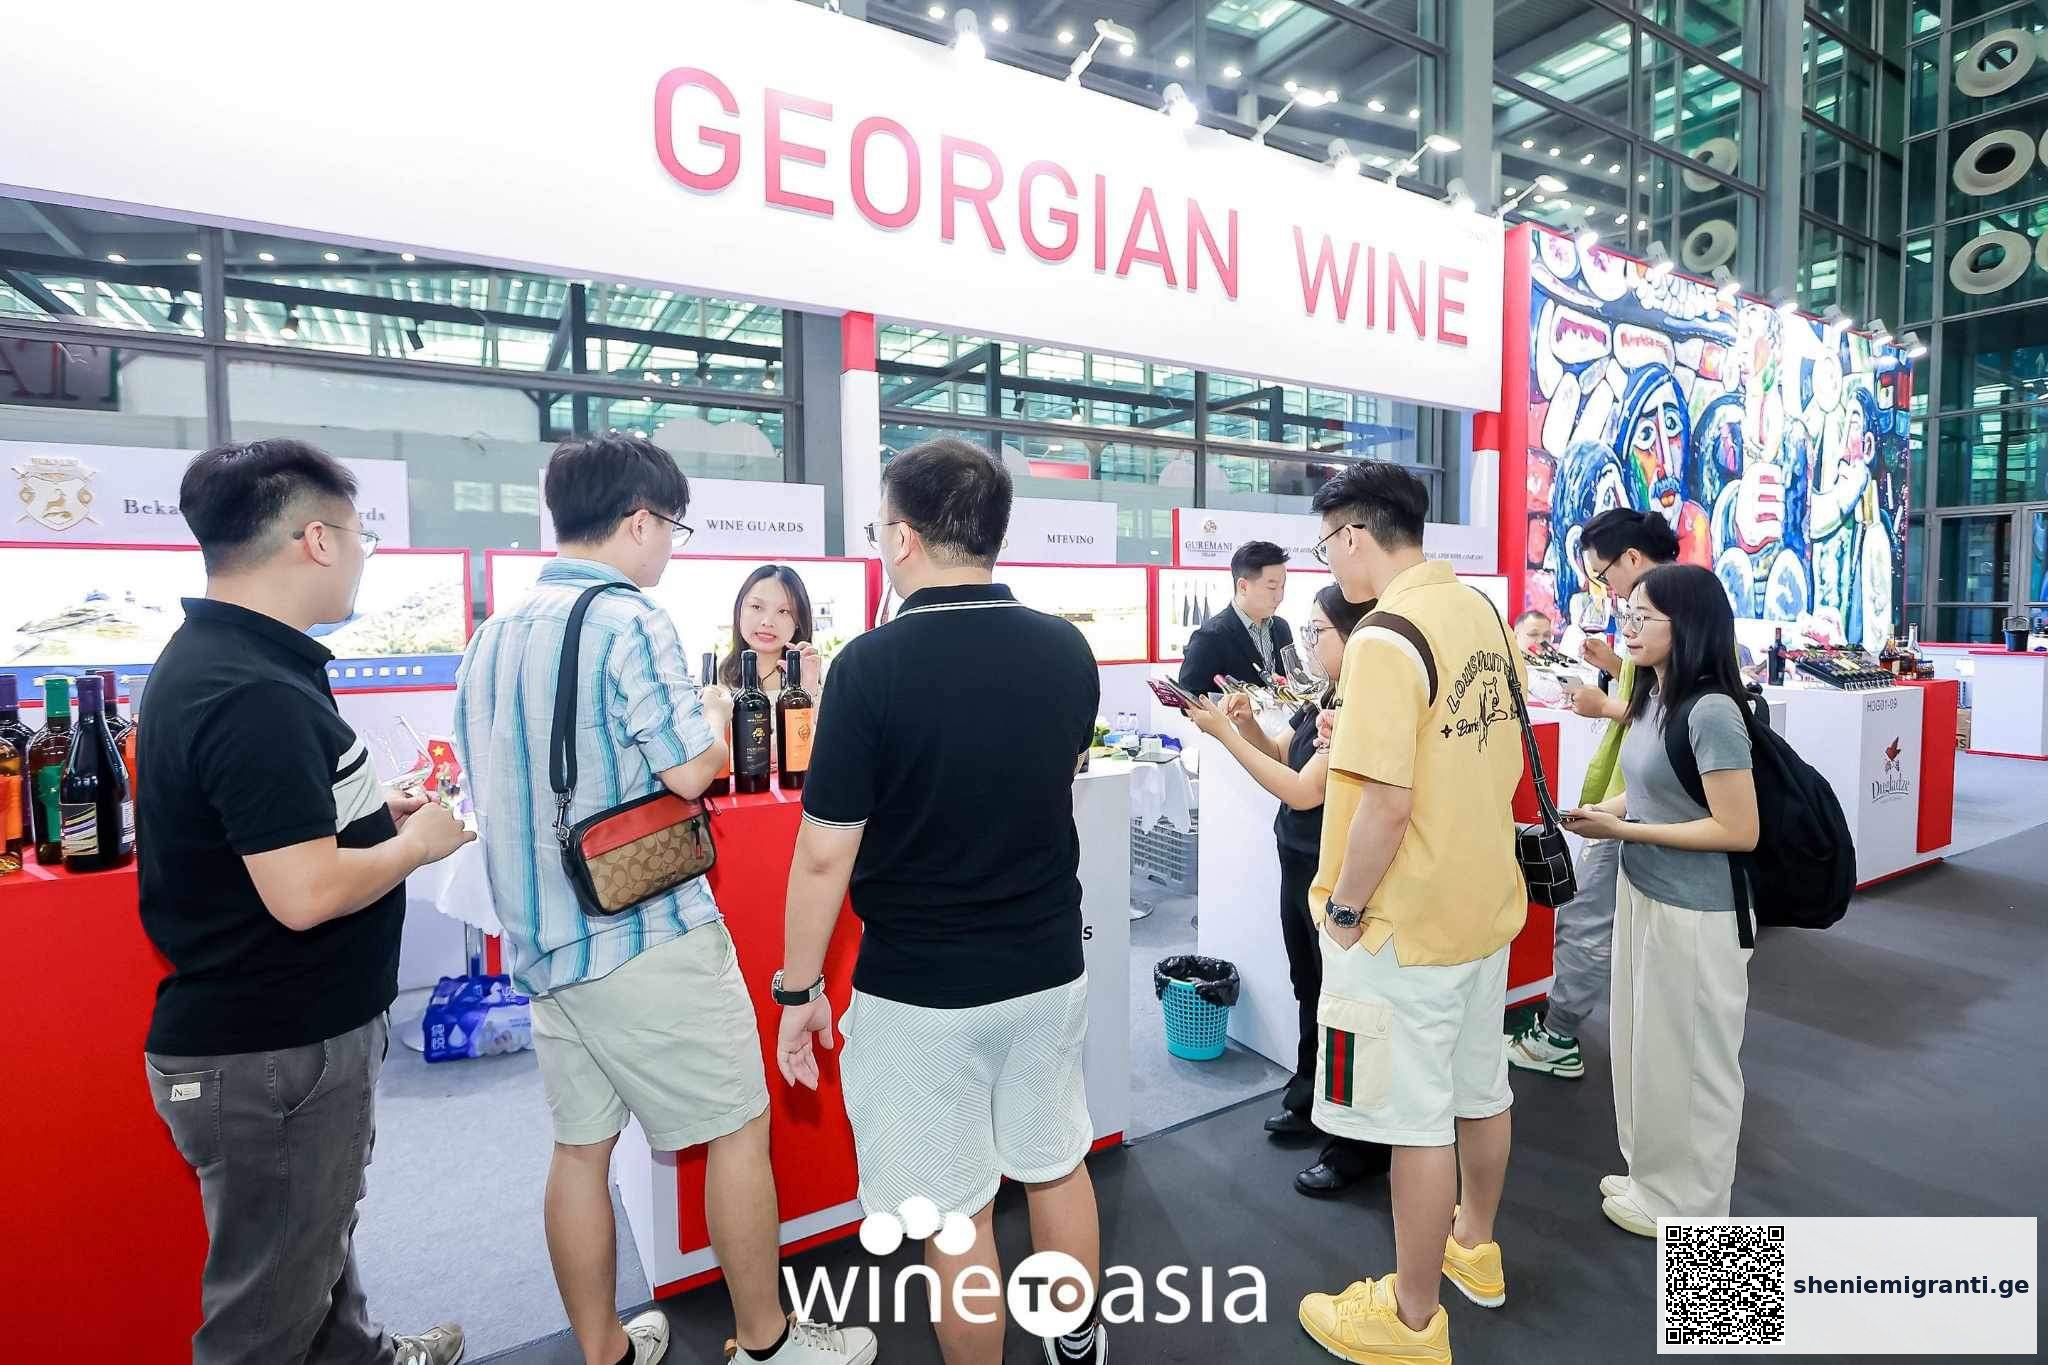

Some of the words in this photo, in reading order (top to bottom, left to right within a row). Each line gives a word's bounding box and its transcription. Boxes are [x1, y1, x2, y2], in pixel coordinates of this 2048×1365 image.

[654, 67, 1239, 300] GEORGIAN
[1293, 223, 1470, 348] WINE
[706, 519, 744, 532] WINE
[746, 520, 804, 533] GUARDS
[1047, 533, 1094, 545] MTEVINO
